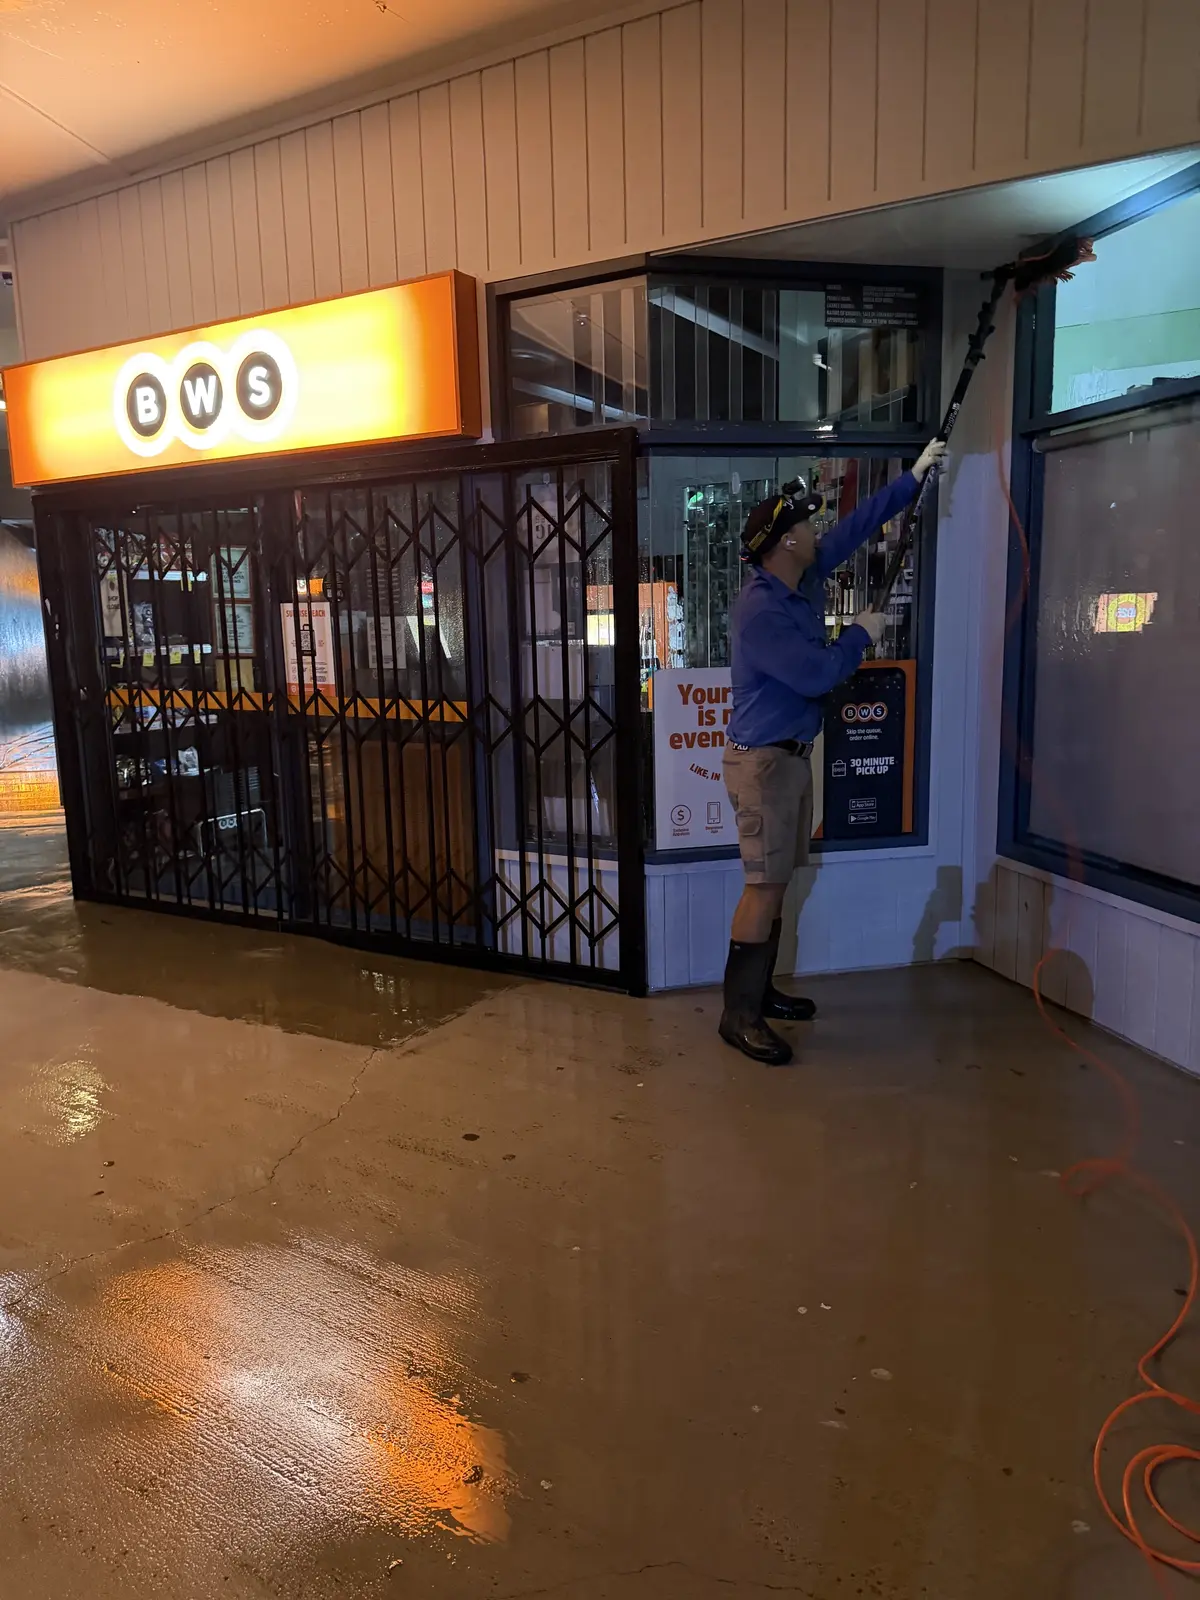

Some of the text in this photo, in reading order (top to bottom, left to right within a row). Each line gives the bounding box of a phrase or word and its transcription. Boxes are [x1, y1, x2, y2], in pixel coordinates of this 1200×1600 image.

[132, 362, 274, 428] BWS
[311, 609, 326, 617] EACH
[677, 683, 732, 706] Your
[697, 705, 717, 726] is
[845, 706, 884, 719] BWS
[669, 730, 725, 750] even
[850, 756, 895, 767] 30 MINUTE
[856, 765, 889, 775] PICK UP
[689, 763, 721, 781] LIKE, IN
